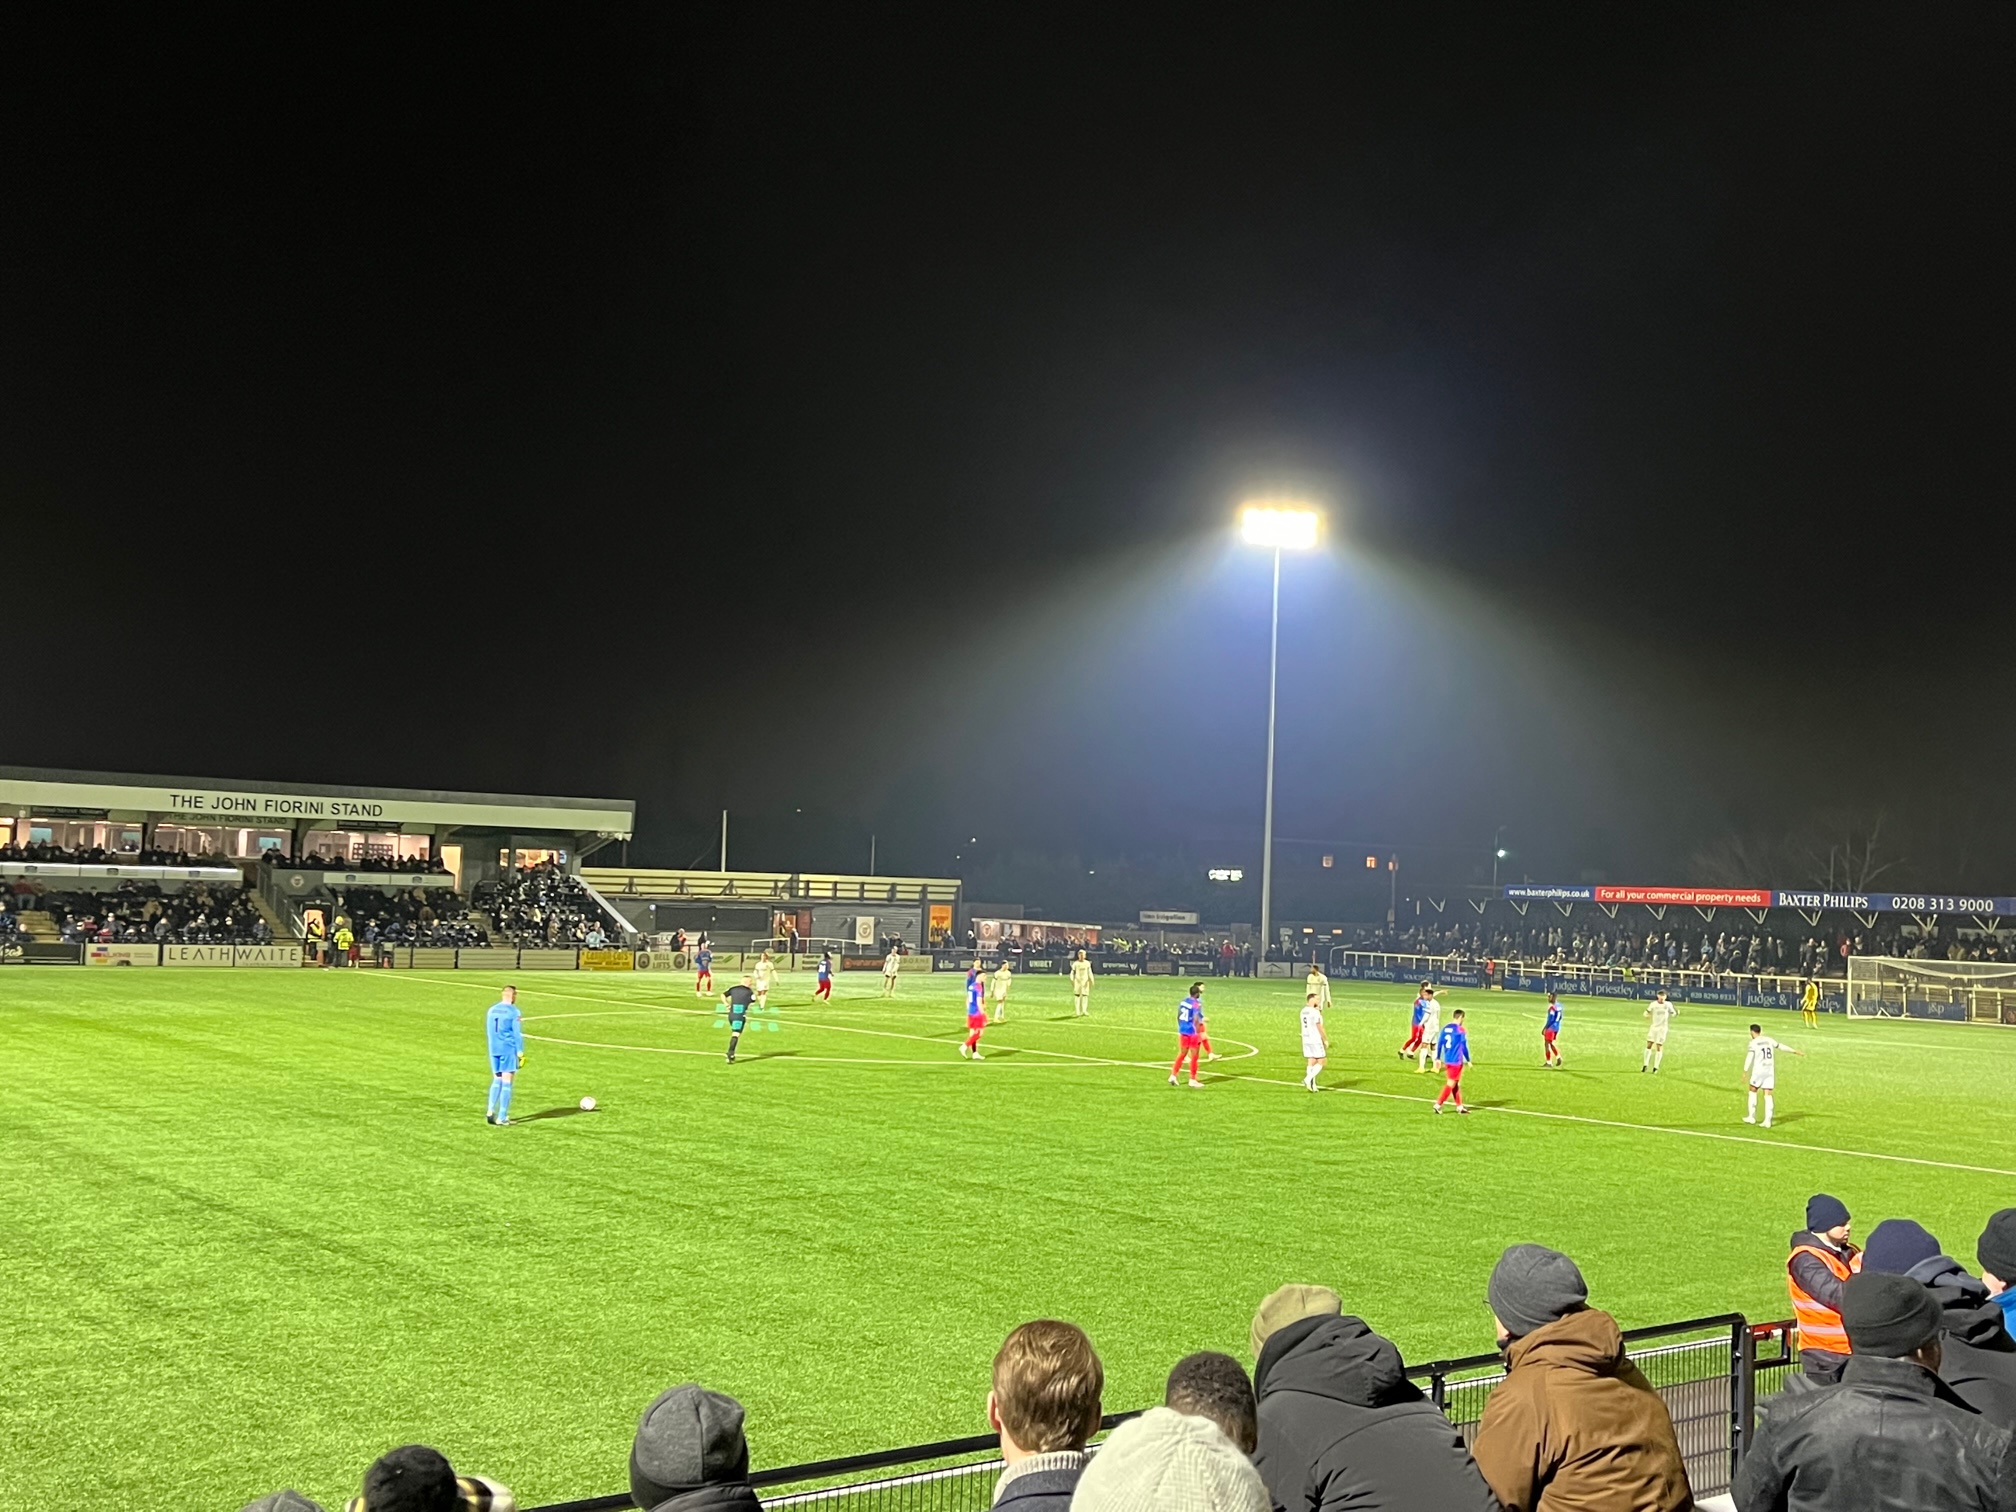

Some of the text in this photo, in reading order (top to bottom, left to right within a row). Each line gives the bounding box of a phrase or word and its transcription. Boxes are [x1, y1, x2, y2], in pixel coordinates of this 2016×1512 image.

[170, 794, 383, 817] THE JOHN FIORINI STAND
[1508, 888, 1590, 899] www.baxterphilips.co.uk
[1601, 889, 1762, 904] For all your commercial property needs
[1779, 893, 1868, 909] BAXTER PHILIPS
[1892, 897, 1994, 912] 0208 313 9000
[168, 947, 298, 960] LEATHWAITE
[1364, 969, 1396, 980] priestley
[1552, 979, 1578, 993] judge
[1580, 981, 1587, 992] &
[1596, 983, 1634, 996] priestley
[1747, 992, 1776, 1007] judge
[1779, 994, 1787, 1006] &
[1761, 1047, 1772, 1060] 18
